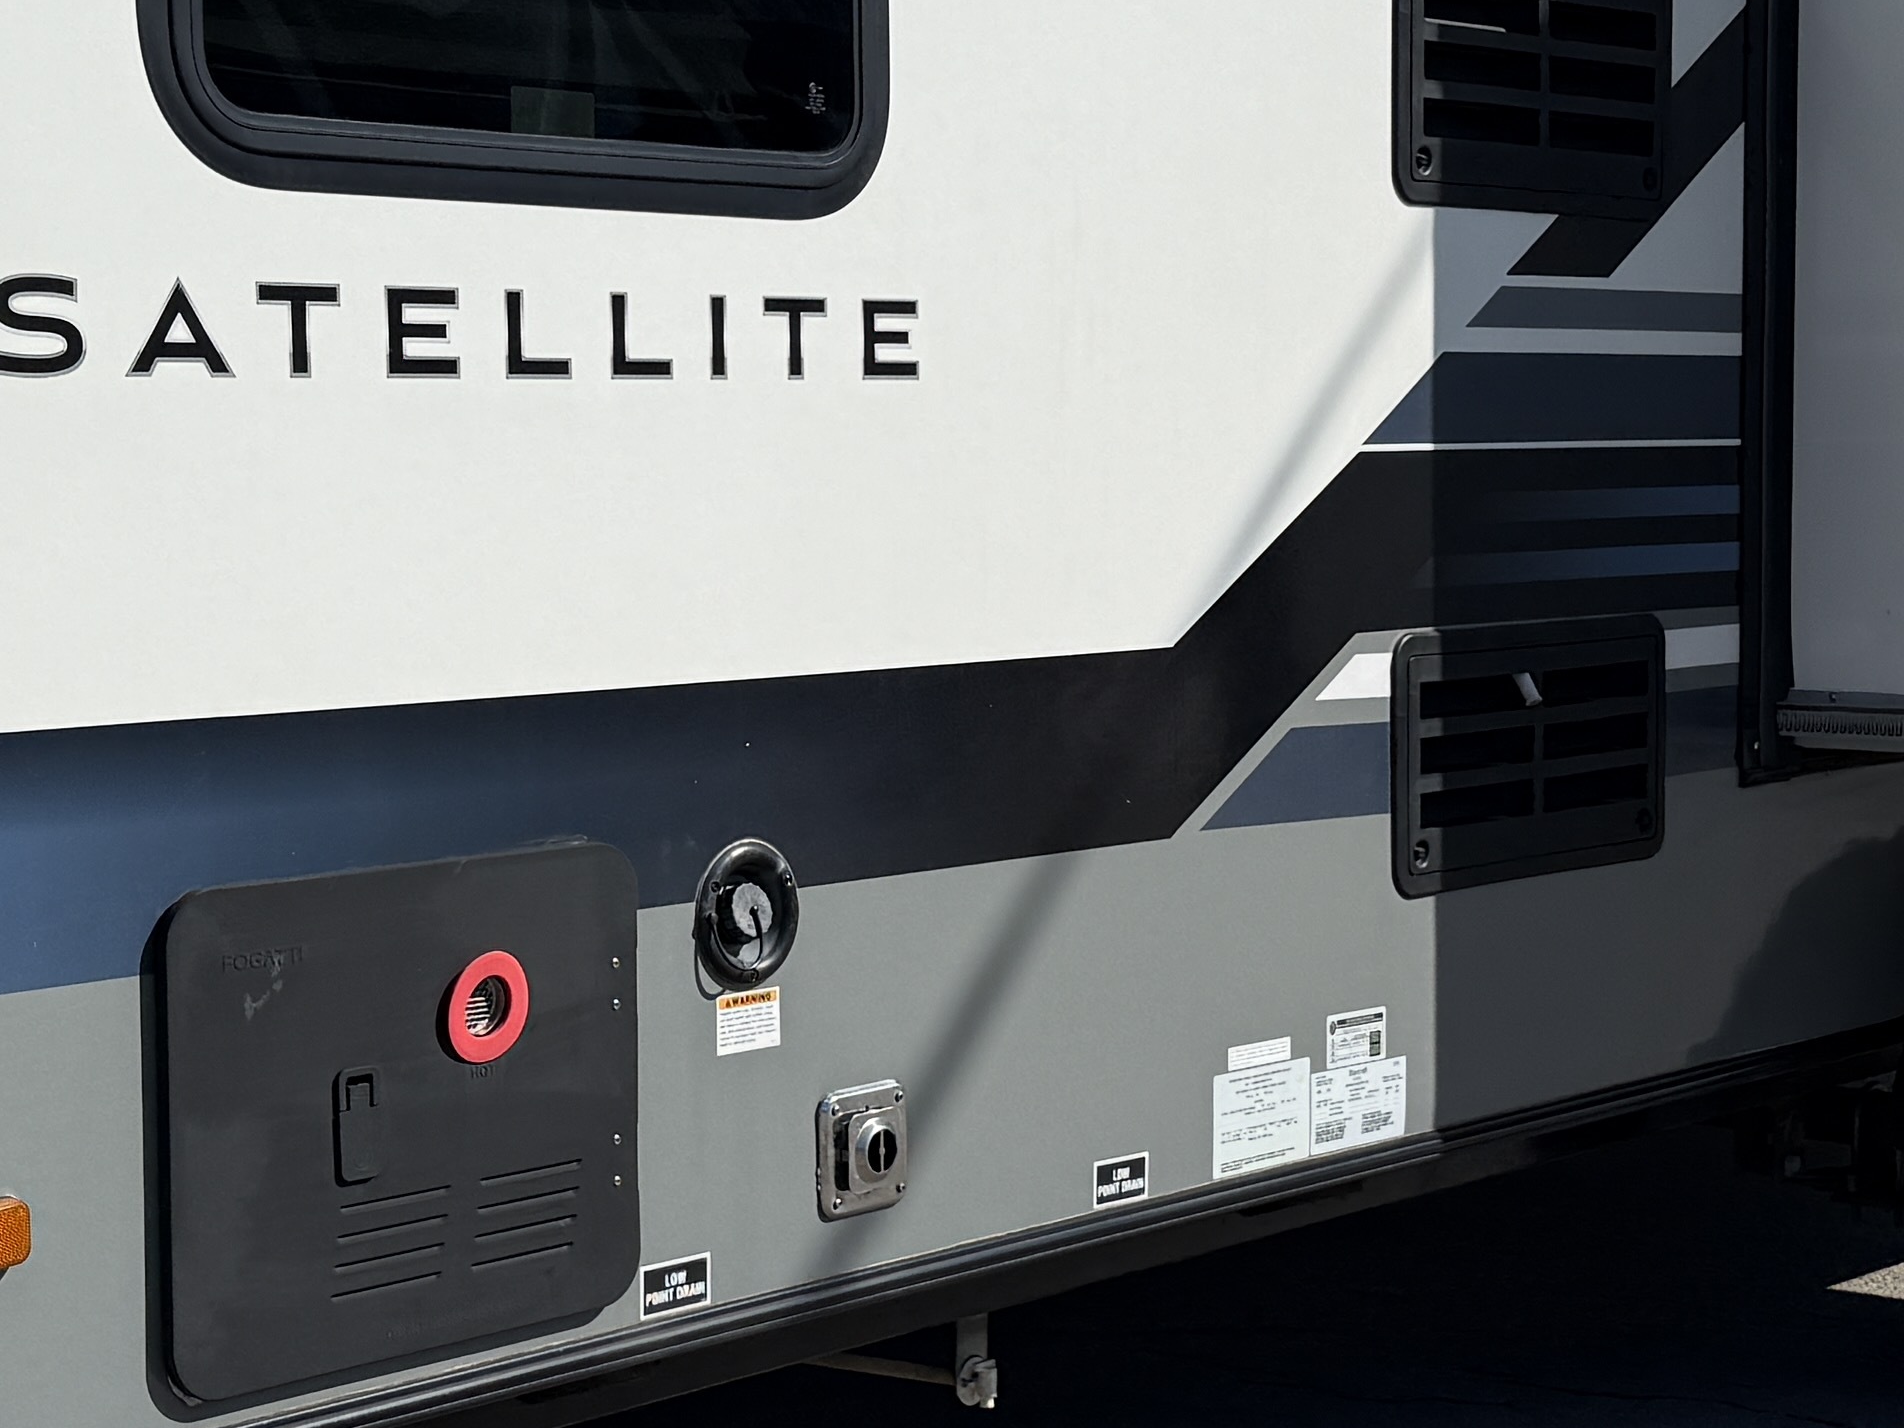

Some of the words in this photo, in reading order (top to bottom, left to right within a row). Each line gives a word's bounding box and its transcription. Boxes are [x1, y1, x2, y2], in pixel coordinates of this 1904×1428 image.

[221, 946, 303, 972] FOGATTI
[664, 1269, 687, 1288] LOW
[645, 1287, 675, 1308] POINT
